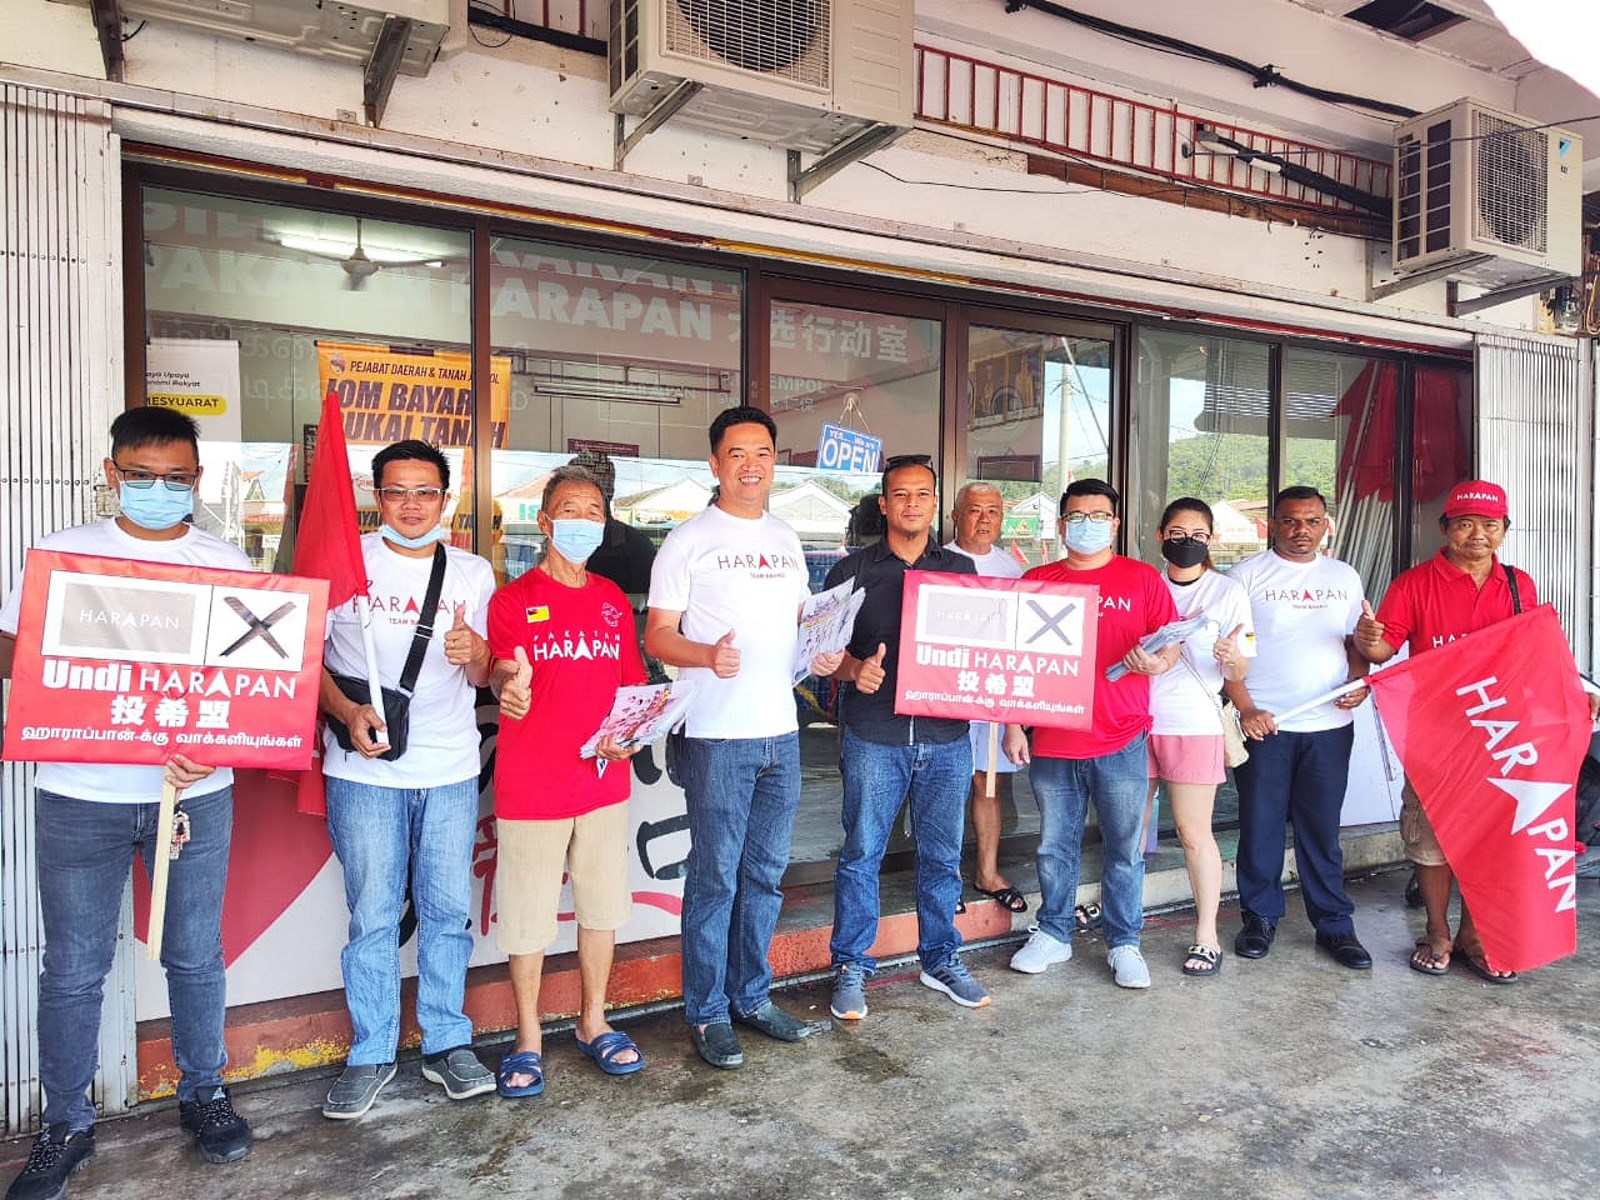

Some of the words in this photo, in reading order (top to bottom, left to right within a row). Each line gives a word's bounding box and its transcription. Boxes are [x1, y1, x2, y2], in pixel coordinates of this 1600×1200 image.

[350, 361, 391, 373] PEJABAT
[391, 364, 427, 377] DAERAH
[429, 367, 435, 378] &
[438, 368, 467, 381] TANAH
[342, 411, 409, 441] UKAI
[823, 439, 876, 473] OPEN
[1456, 492, 1498, 503] HARAPAN
[718, 553, 799, 571] HARAPAN
[1265, 588, 1348, 601] HARAPAN
[79, 608, 180, 630] HARAPAN
[389, 618, 414, 626] TEAM
[533, 637, 620, 661] HARAPAN
[916, 644, 970, 668] Undi
[974, 651, 1079, 677] HARAPAN
[42, 659, 132, 691] Undi
[139, 669, 297, 699] HARAPAN
[957, 670, 1035, 697] 投希盟
[110, 695, 230, 729] 投希盟
[1456, 676, 1575, 914] HARAPAN
